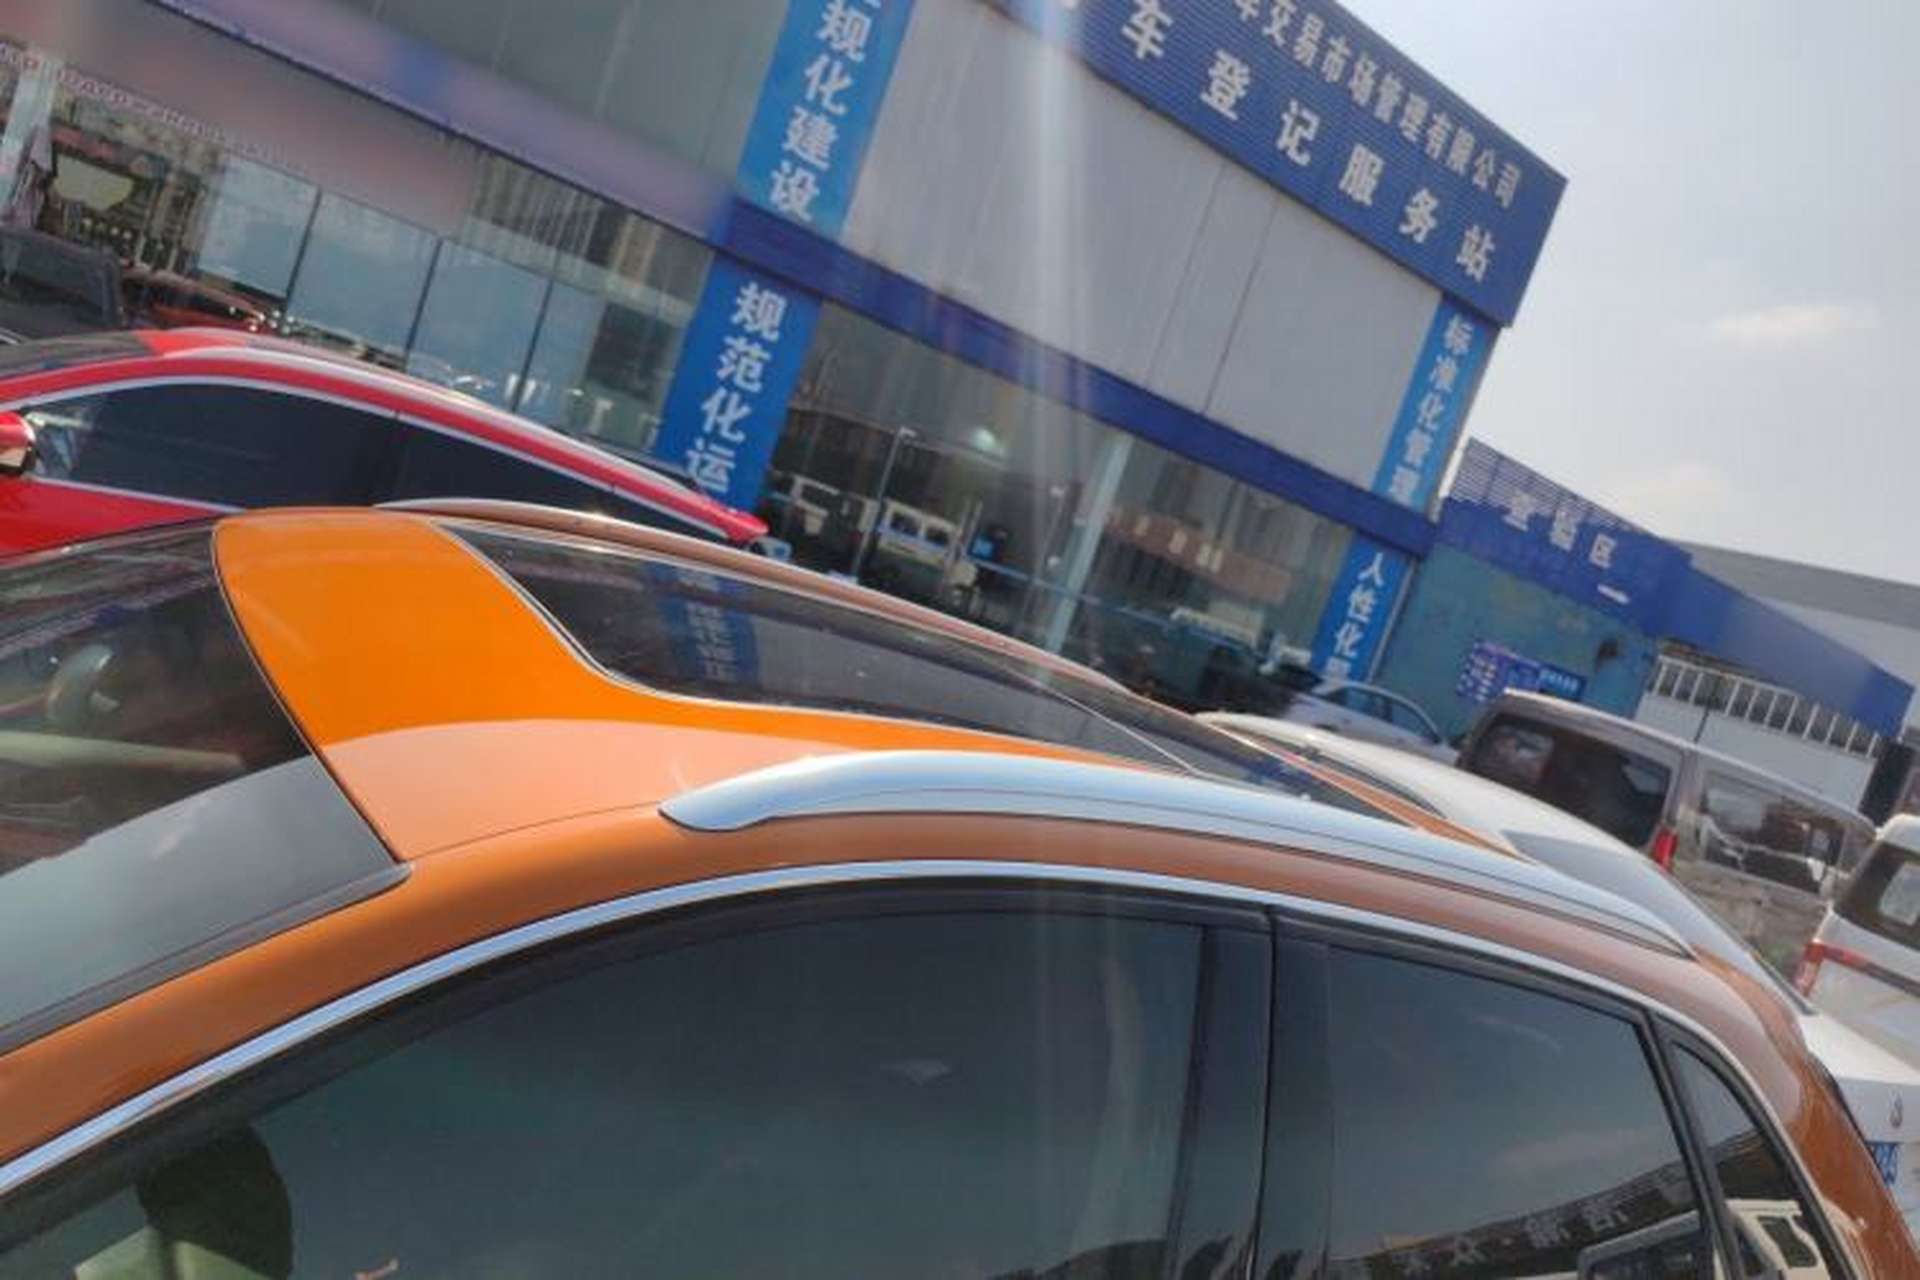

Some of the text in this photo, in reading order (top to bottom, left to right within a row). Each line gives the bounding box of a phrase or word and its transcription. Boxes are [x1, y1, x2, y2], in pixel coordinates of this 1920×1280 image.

[769, 0, 880, 222] 规化建设
[686, 281, 786, 494] 规范化运
